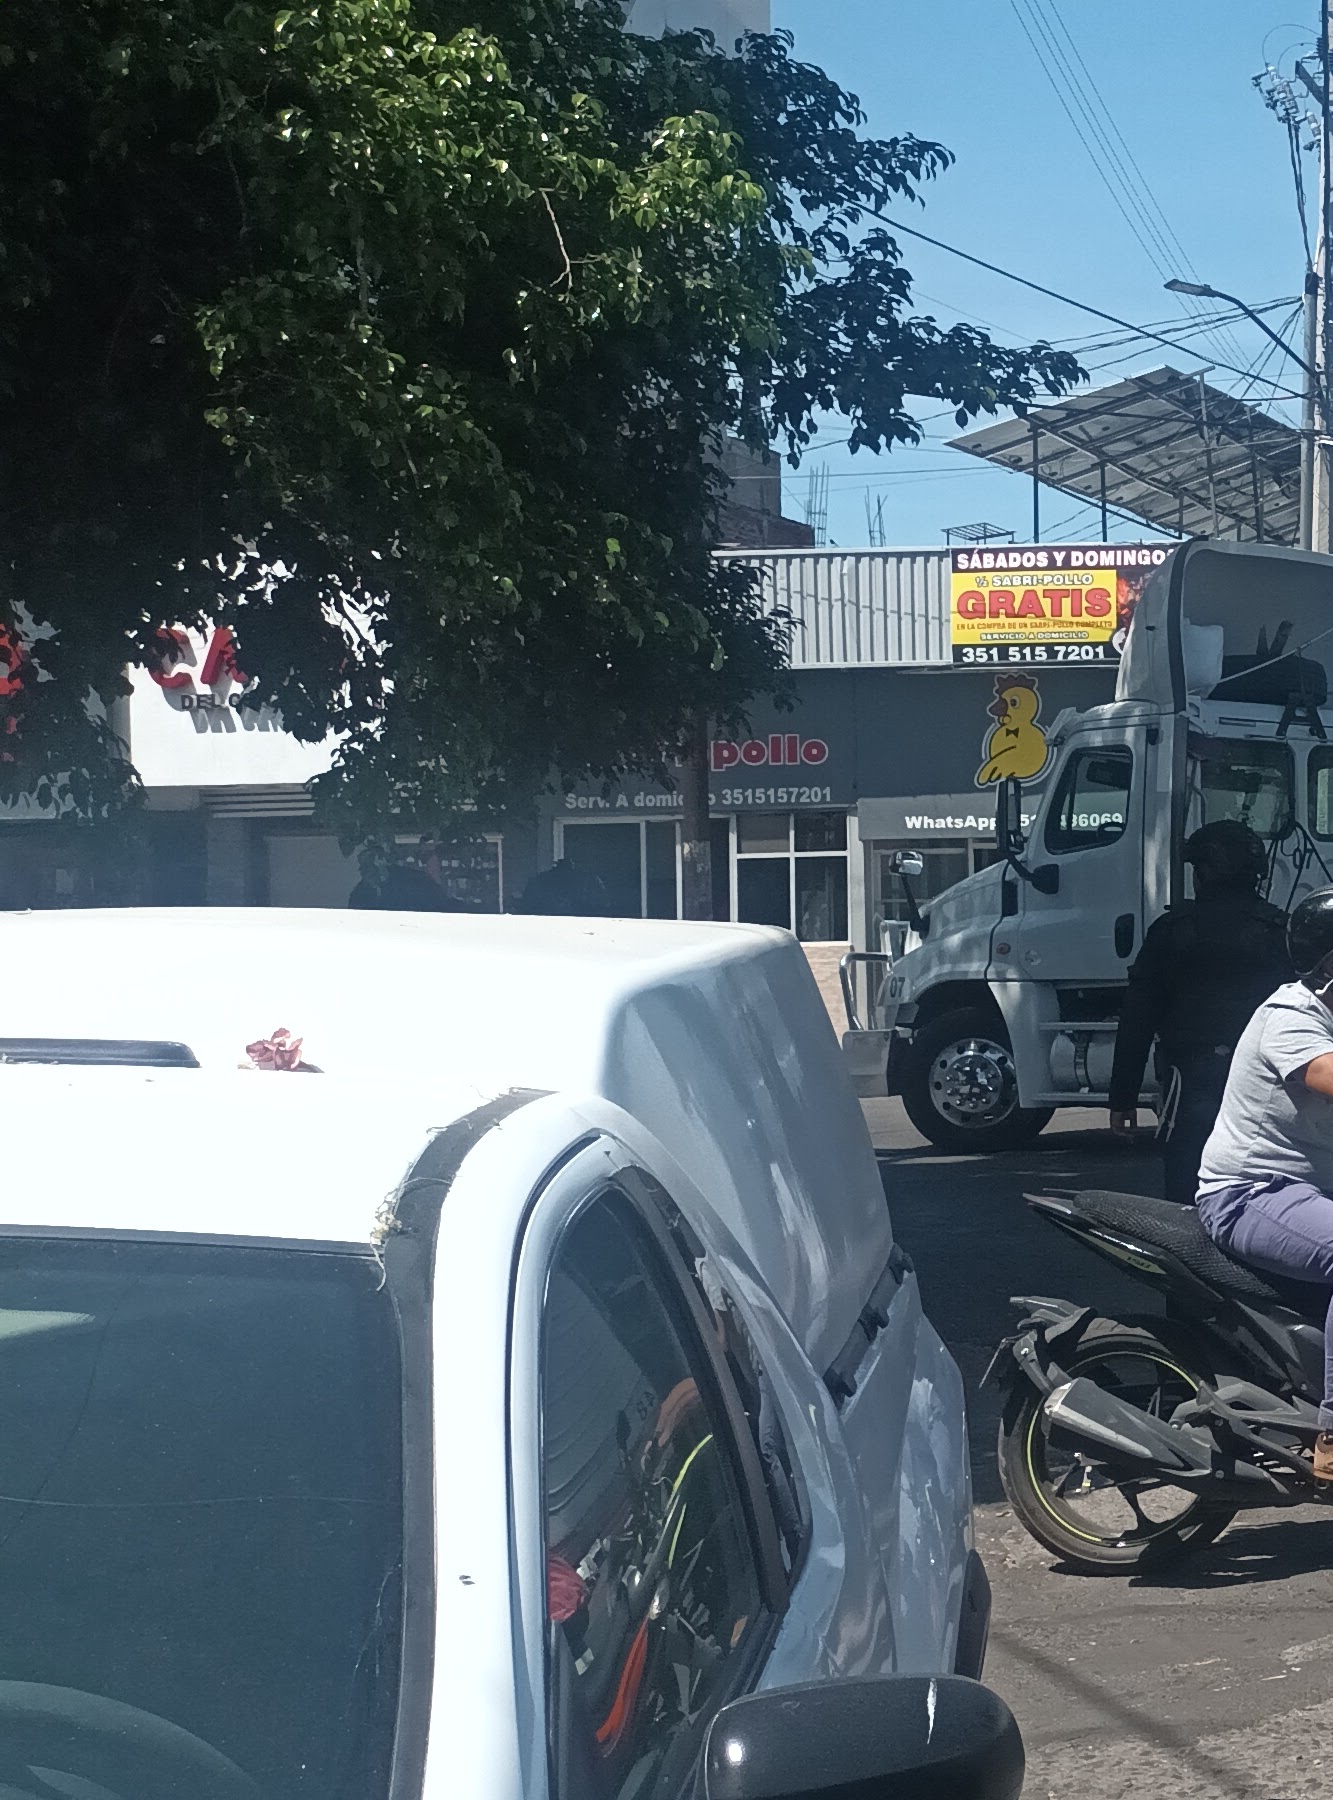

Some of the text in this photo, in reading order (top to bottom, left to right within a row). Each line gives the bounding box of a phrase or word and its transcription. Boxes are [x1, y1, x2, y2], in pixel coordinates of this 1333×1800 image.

[957, 549, 1049, 570] SÁBADOS
[1053, 551, 1067, 567] Y
[992, 573, 1094, 587] SABRI-POLLO
[956, 587, 1113, 621] GRATIS
[980, 631, 1090, 641] SERVICIO A DOMICILIO
[962, 645, 1105, 663] 351 515 7201
[710, 733, 829, 772] pollo
[722, 786, 832, 806] 3515157201
[889, 976, 906, 998] 07
